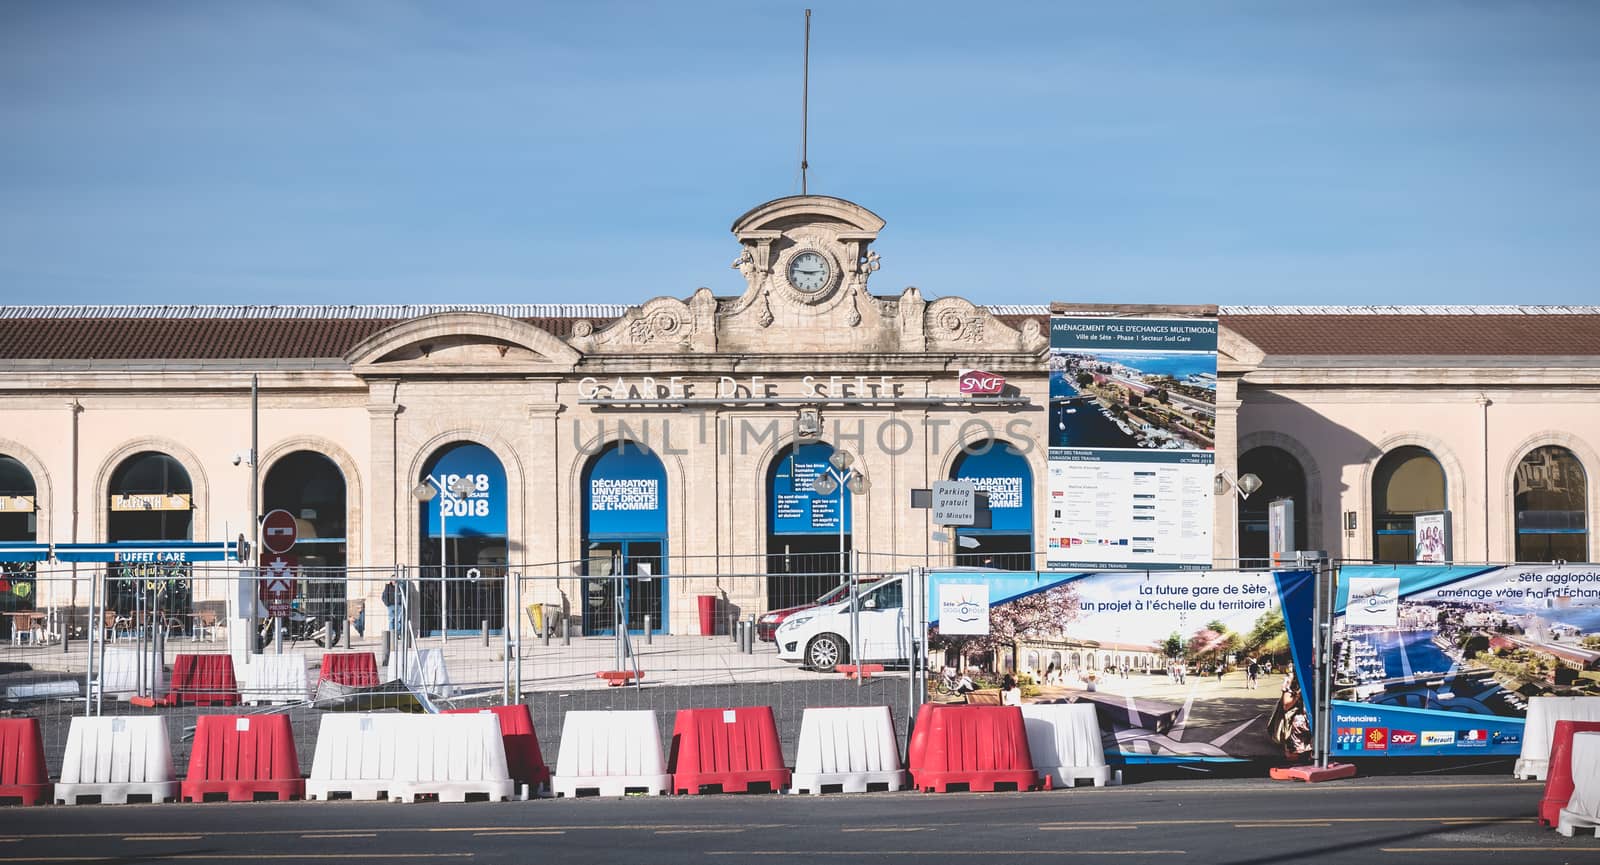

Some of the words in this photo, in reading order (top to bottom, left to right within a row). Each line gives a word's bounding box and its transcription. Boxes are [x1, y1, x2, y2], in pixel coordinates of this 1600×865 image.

[578, 376, 684, 400] GARE
[720, 376, 764, 400] DE
[962, 377, 1004, 392] SNCF
[592, 478, 655, 487] DÉCLARATION
[958, 477, 1018, 485] CLARATION
[939, 488, 970, 497] Parking
[940, 499, 968, 507] gratuit
[440, 500, 489, 517] 2018
[114, 552, 154, 561] BUFFET
[157, 552, 186, 561] GARE
[1519, 572, 1542, 582] Sète
[1139, 585, 1153, 595] La
[1156, 584, 1189, 594] future
[1192, 587, 1219, 597] gare
[1223, 584, 1238, 594] de
[1242, 584, 1271, 595] Sète,
[1438, 588, 1492, 599] aménage
[1098, 600, 1132, 612] projet
[1135, 600, 1143, 610] à
[1146, 600, 1197, 610] l'échelle
[1200, 600, 1215, 610] du
[1218, 599, 1265, 610] territoire
